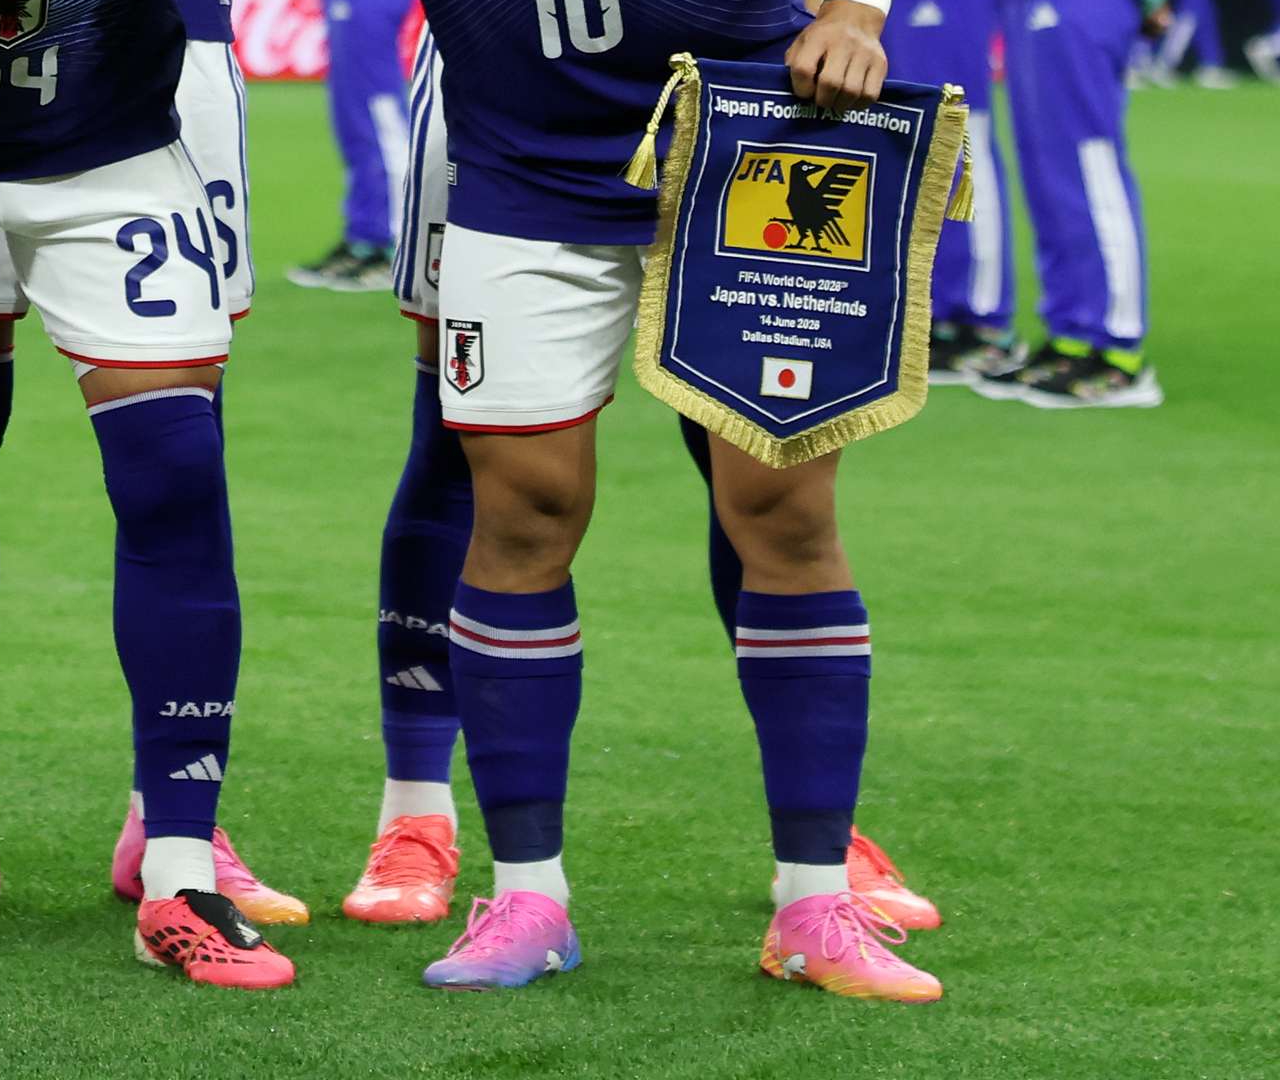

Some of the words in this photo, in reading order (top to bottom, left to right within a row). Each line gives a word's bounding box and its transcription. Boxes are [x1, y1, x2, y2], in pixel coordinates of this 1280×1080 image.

[714, 96, 759, 118] Japan
[763, 100, 817, 120] Football
[736, 159, 785, 185] JFA
[116, 207, 220, 317] 24
[738, 271, 761, 284] FIFA
[762, 273, 794, 287] World
[796, 276, 817, 291] Cup
[710, 286, 756, 307] Japan
[758, 293, 781, 308] vs.
[783, 292, 867, 317] Netherlands
[451, 321, 473, 329] JAPAN
[759, 314, 772, 326] 14
[772, 316, 796, 328] June
[797, 318, 820, 330] 2026
[742, 330, 772, 344] Dallas
[814, 338, 832, 350] USA
